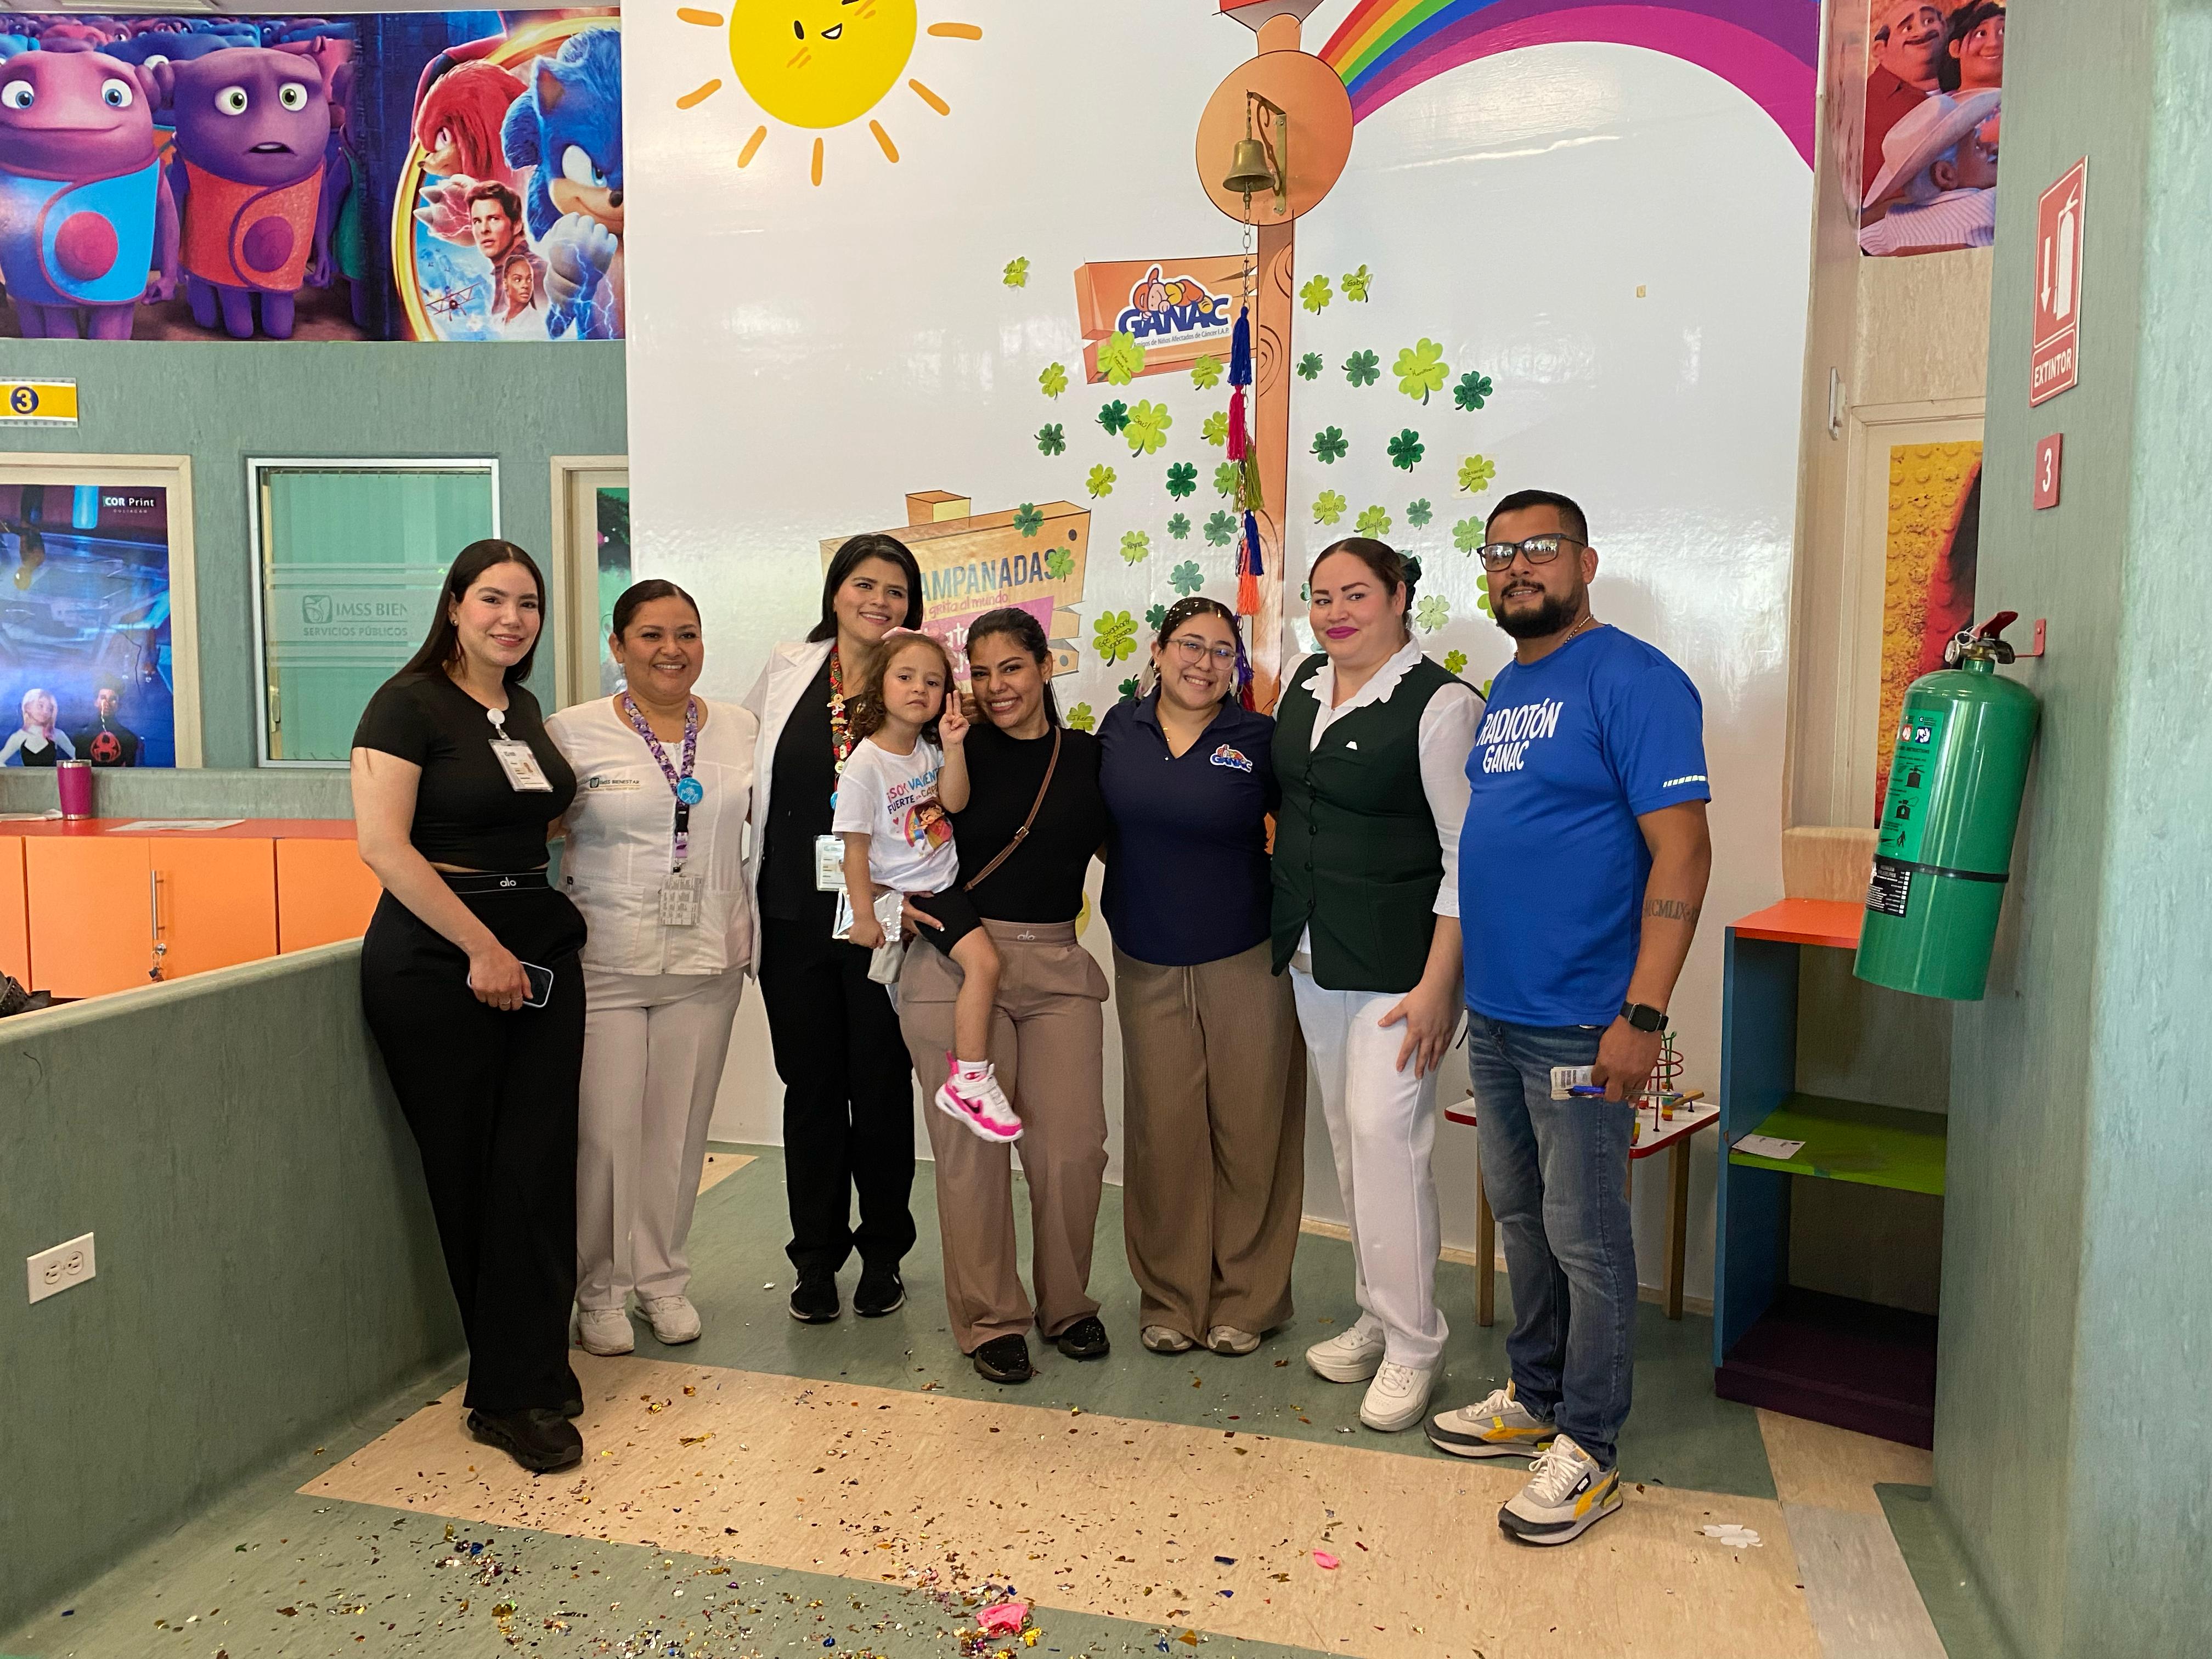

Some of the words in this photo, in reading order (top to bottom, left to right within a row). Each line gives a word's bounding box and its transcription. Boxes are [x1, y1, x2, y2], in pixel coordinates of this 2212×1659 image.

[1347, 279, 1364, 290] Gaby
[1118, 298, 1229, 339] GANAC
[1172, 332, 1194, 342] Afectados
[1201, 329, 1217, 337] Cáncer
[2034, 348, 2072, 388] EXTINTOR
[16, 389, 32, 411] 3
[1133, 415, 1151, 430] Saúl
[2042, 448, 2052, 493] 3
[105, 497, 126, 506] COR
[129, 497, 154, 507] Print
[921, 549, 1057, 601] AMPANADAS
[336, 603, 371, 616] IMSS
[960, 596, 970, 610] al
[972, 590, 1008, 607] mundo
[303, 627, 354, 636] SERVICIOS
[359, 625, 408, 636] PÚBLICOS
[1476, 697, 1564, 747] RADIOTÓN
[1482, 740, 1530, 774] GANAC
[887, 794, 916, 815] FUERTE
[500, 877, 517, 887] alo
[1017, 930, 1036, 941] alo
